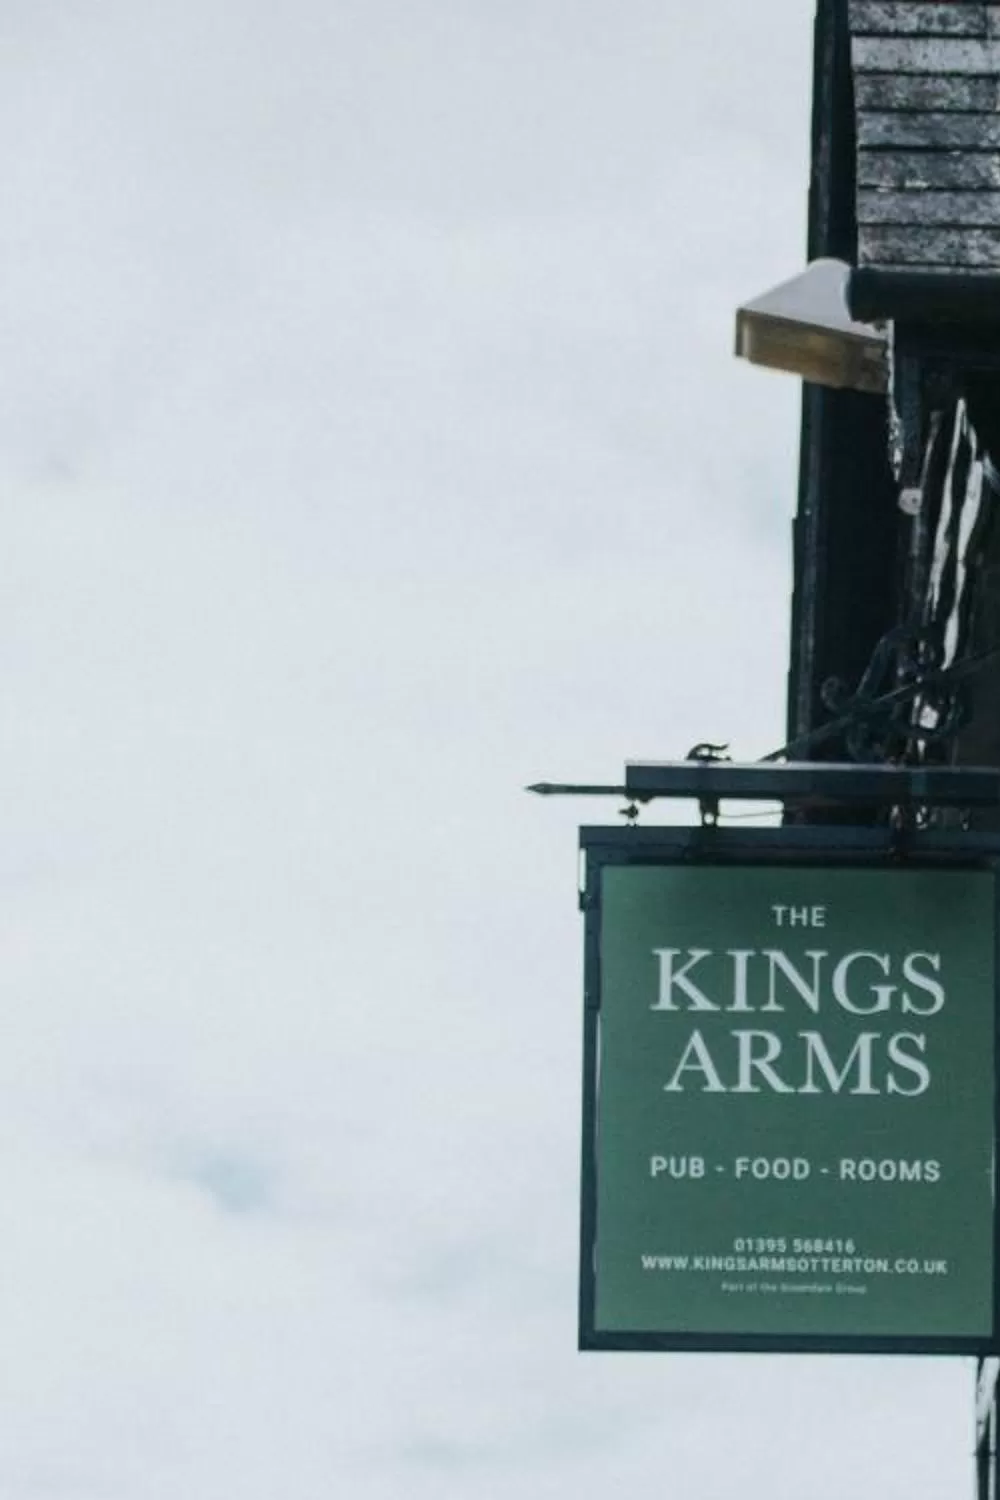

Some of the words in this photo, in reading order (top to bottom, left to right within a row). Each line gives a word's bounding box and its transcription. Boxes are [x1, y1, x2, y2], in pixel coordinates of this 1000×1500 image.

[771, 904, 826, 928] THE
[649, 946, 946, 1016] KINGS
[662, 1028, 932, 1097] ARMS
[650, 1155, 705, 1179] PUB
[734, 1156, 810, 1180] FOOD
[839, 1157, 941, 1183] ROOMS
[733, 1237, 787, 1253] 01395
[640, 1254, 948, 1274] WWW.KINGSARMSOTTERTON.CO.UK
